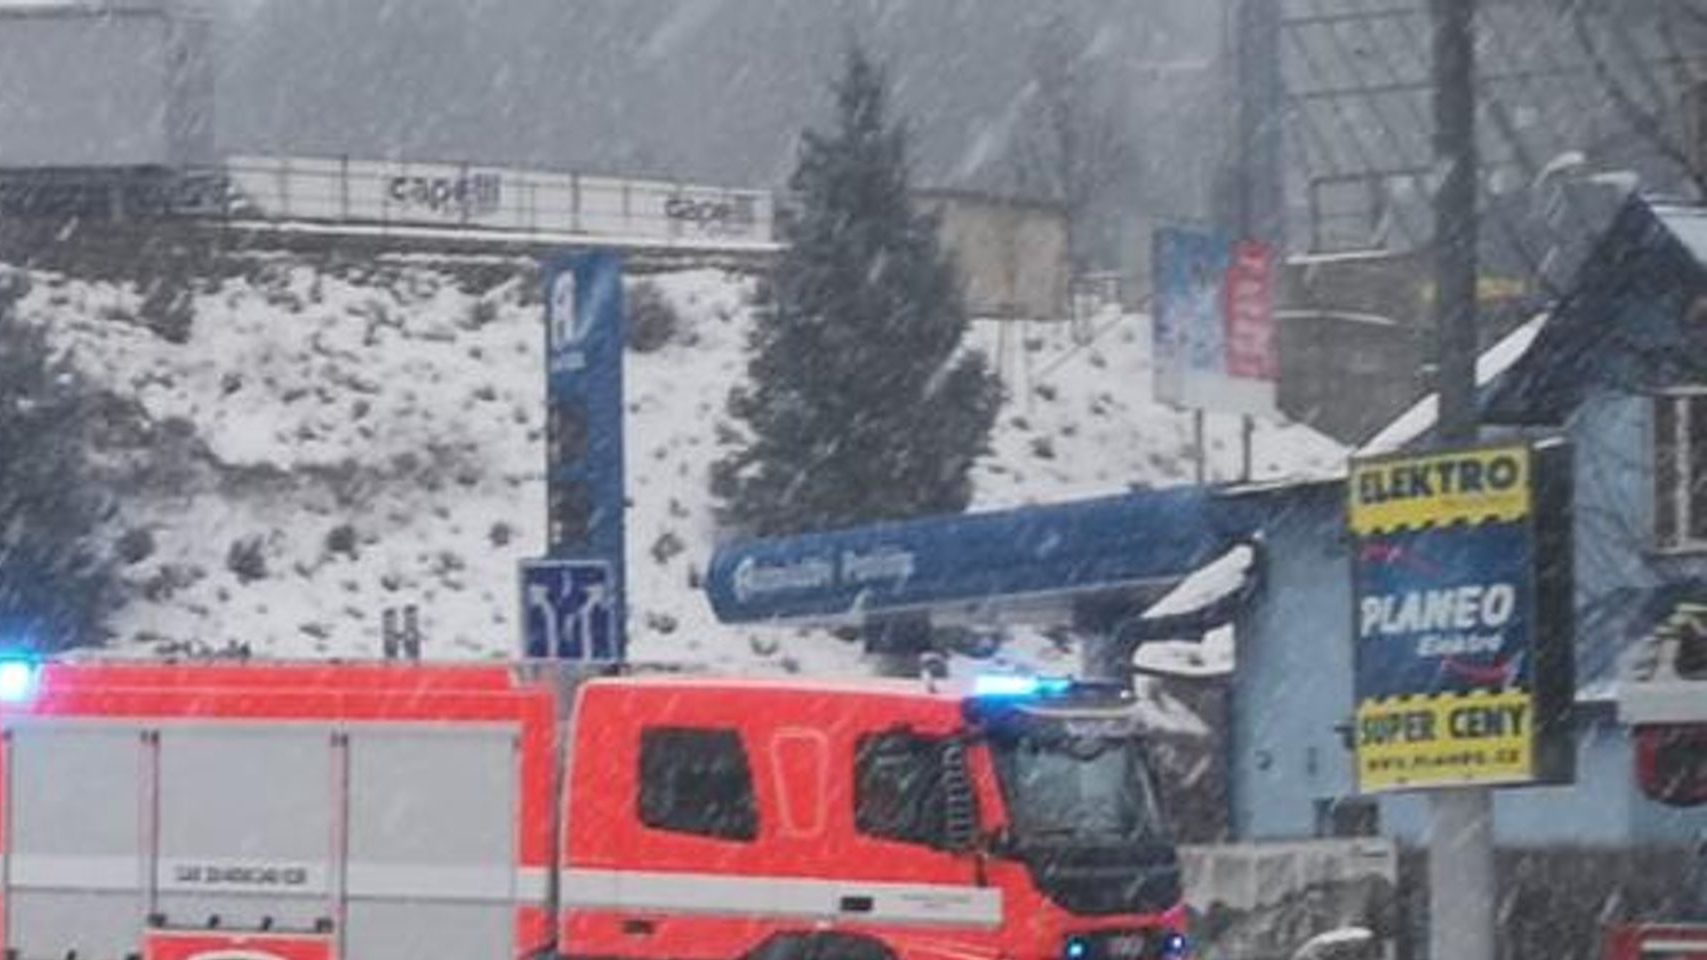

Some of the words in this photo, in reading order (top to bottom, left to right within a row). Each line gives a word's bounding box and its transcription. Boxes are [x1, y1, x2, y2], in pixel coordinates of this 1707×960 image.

[1358, 455, 1520, 504] ELEKTRO
[1360, 582, 1516, 638] PLANEO
[1361, 709, 1438, 747] SUPER
[1447, 704, 1527, 740] CENY
